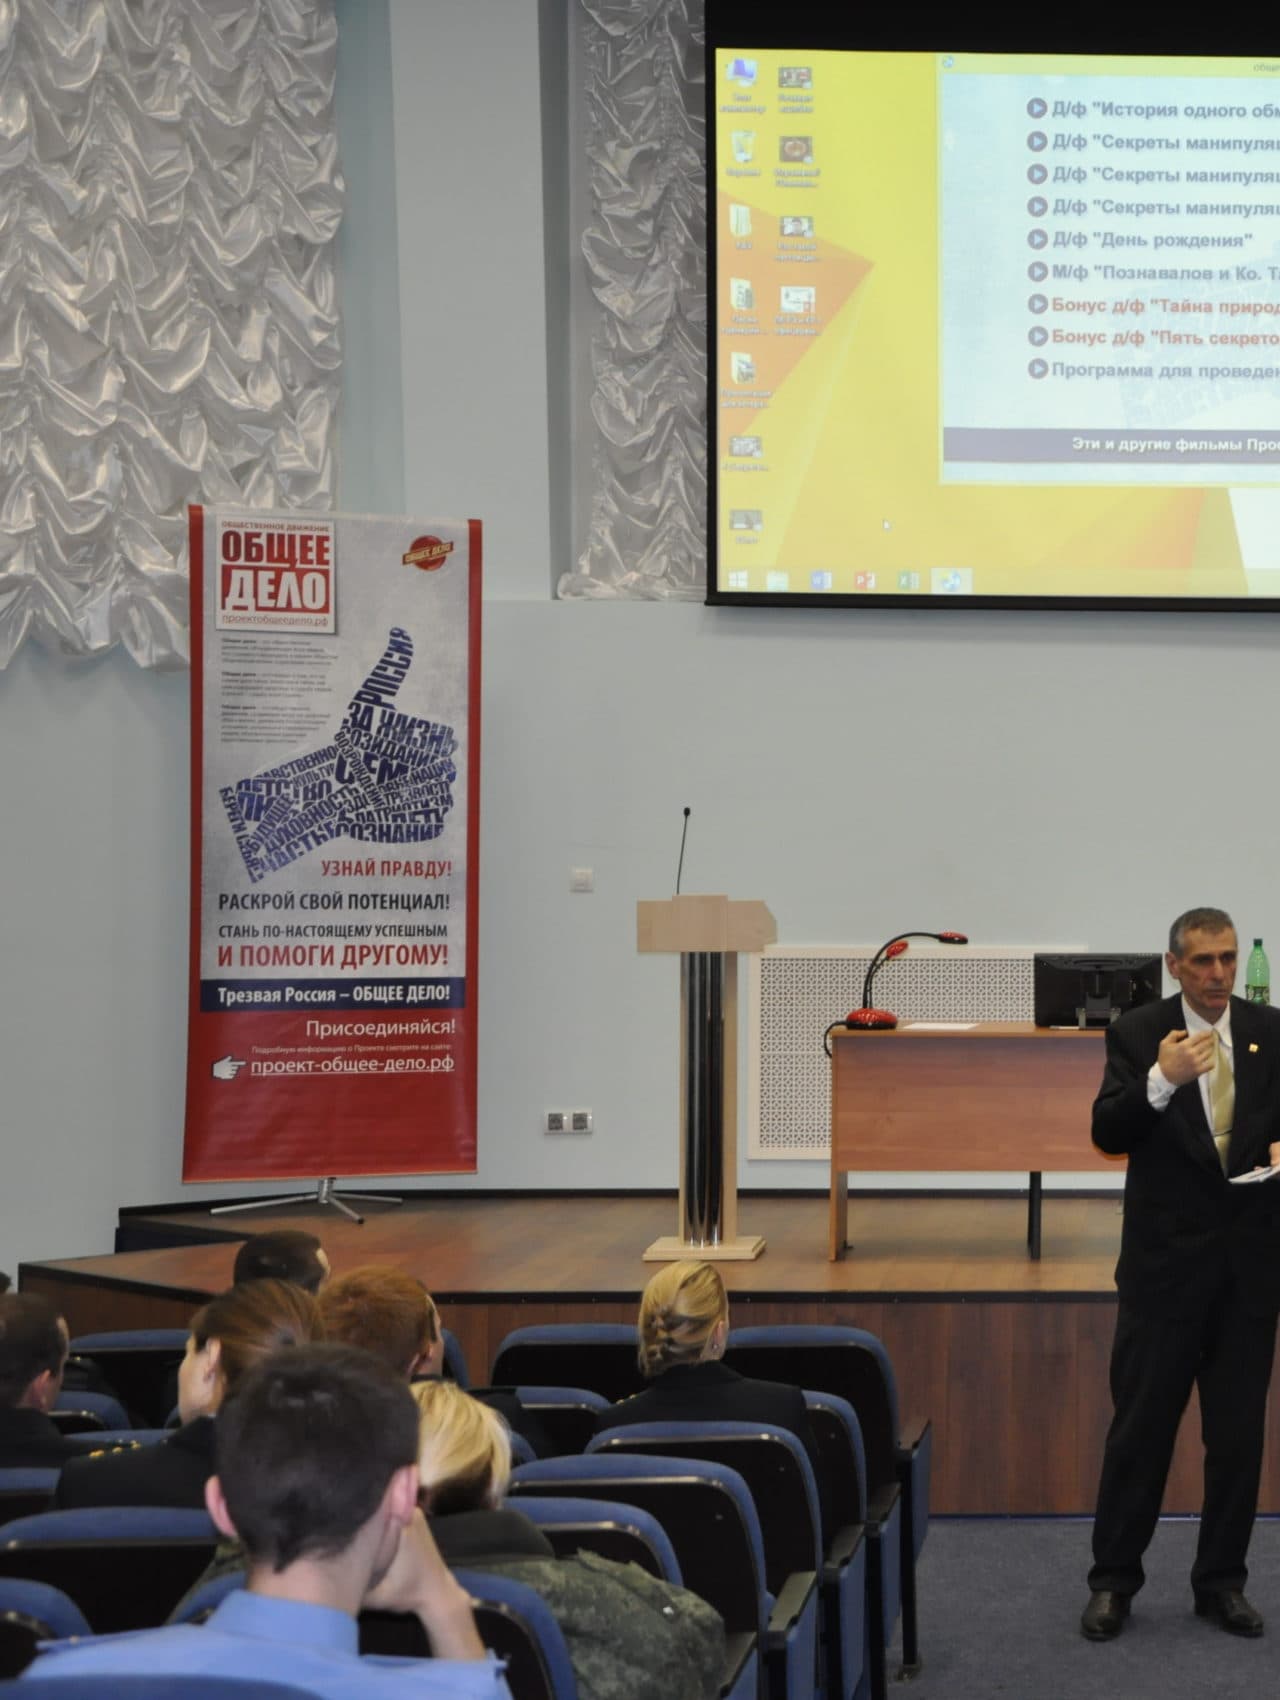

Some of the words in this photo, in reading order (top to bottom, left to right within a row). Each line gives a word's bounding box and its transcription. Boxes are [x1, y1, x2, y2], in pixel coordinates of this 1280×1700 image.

[1052, 101, 1087, 119] Д/ф
[1092, 101, 1178, 119] "История
[1183, 104, 1247, 119] одного
[1052, 134, 1087, 151] Д/ф
[1092, 134, 1180, 151] "Секреты
[1052, 166, 1087, 183] Д/ф
[1092, 167, 1180, 184] "Секреты
[1052, 199, 1087, 216] Д/ф
[1092, 200, 1180, 217] "Секреты
[1052, 231, 1088, 248] Д/ф
[1093, 232, 1148, 248] "День
[1154, 234, 1252, 249] рождения"
[1052, 264, 1088, 282] М/ф
[1093, 265, 1213, 281] "Познавалов
[1219, 269, 1230, 281] и
[1235, 266, 1262, 281] Ко.
[1052, 297, 1107, 315] Бонус
[1112, 298, 1145, 315] д/ф
[1150, 298, 1213, 314] "Тайна
[1052, 329, 1107, 347] Бонус
[1112, 330, 1145, 347] д/ф
[1151, 330, 1204, 345] "Пять
[1052, 362, 1153, 380] Программа
[1159, 366, 1193, 380] для
[1072, 437, 1101, 450] Эти
[1105, 440, 1115, 450] и
[1118, 440, 1171, 453] другие
[1176, 437, 1242, 453] фильмы
[222, 530, 330, 568] ОБЩЕЕ
[225, 569, 327, 614] ДЕЛО
[343, 702, 374, 731] ЗА
[376, 709, 459, 757] ЖИЗНЬ
[321, 858, 376, 877] УЗНАЙ
[381, 860, 452, 879] ПРАВДУ!
[219, 891, 295, 910] РАСКРОЙ
[300, 891, 343, 910] СВОЙ
[348, 893, 450, 912] ПОТЕНЦИАЛ!
[219, 925, 259, 938] СТАНЬ
[263, 925, 372, 939] ПО-НАСТОЯЩЕМУ
[374, 925, 448, 938] УСПЕШНЫМ
[218, 945, 232, 967] И
[240, 945, 335, 967] ПОМОГИ
[340, 944, 449, 970] ДРУГОМУ!
[218, 987, 281, 1007] Трезвая
[285, 986, 337, 1003] Россия
[353, 985, 404, 1004] ОБЩЕЕ
[406, 985, 451, 1004] ДЕЛО!
[306, 1018, 456, 1040] Присоединяйся!
[251, 1054, 455, 1075] проект-общее-дело.рф
